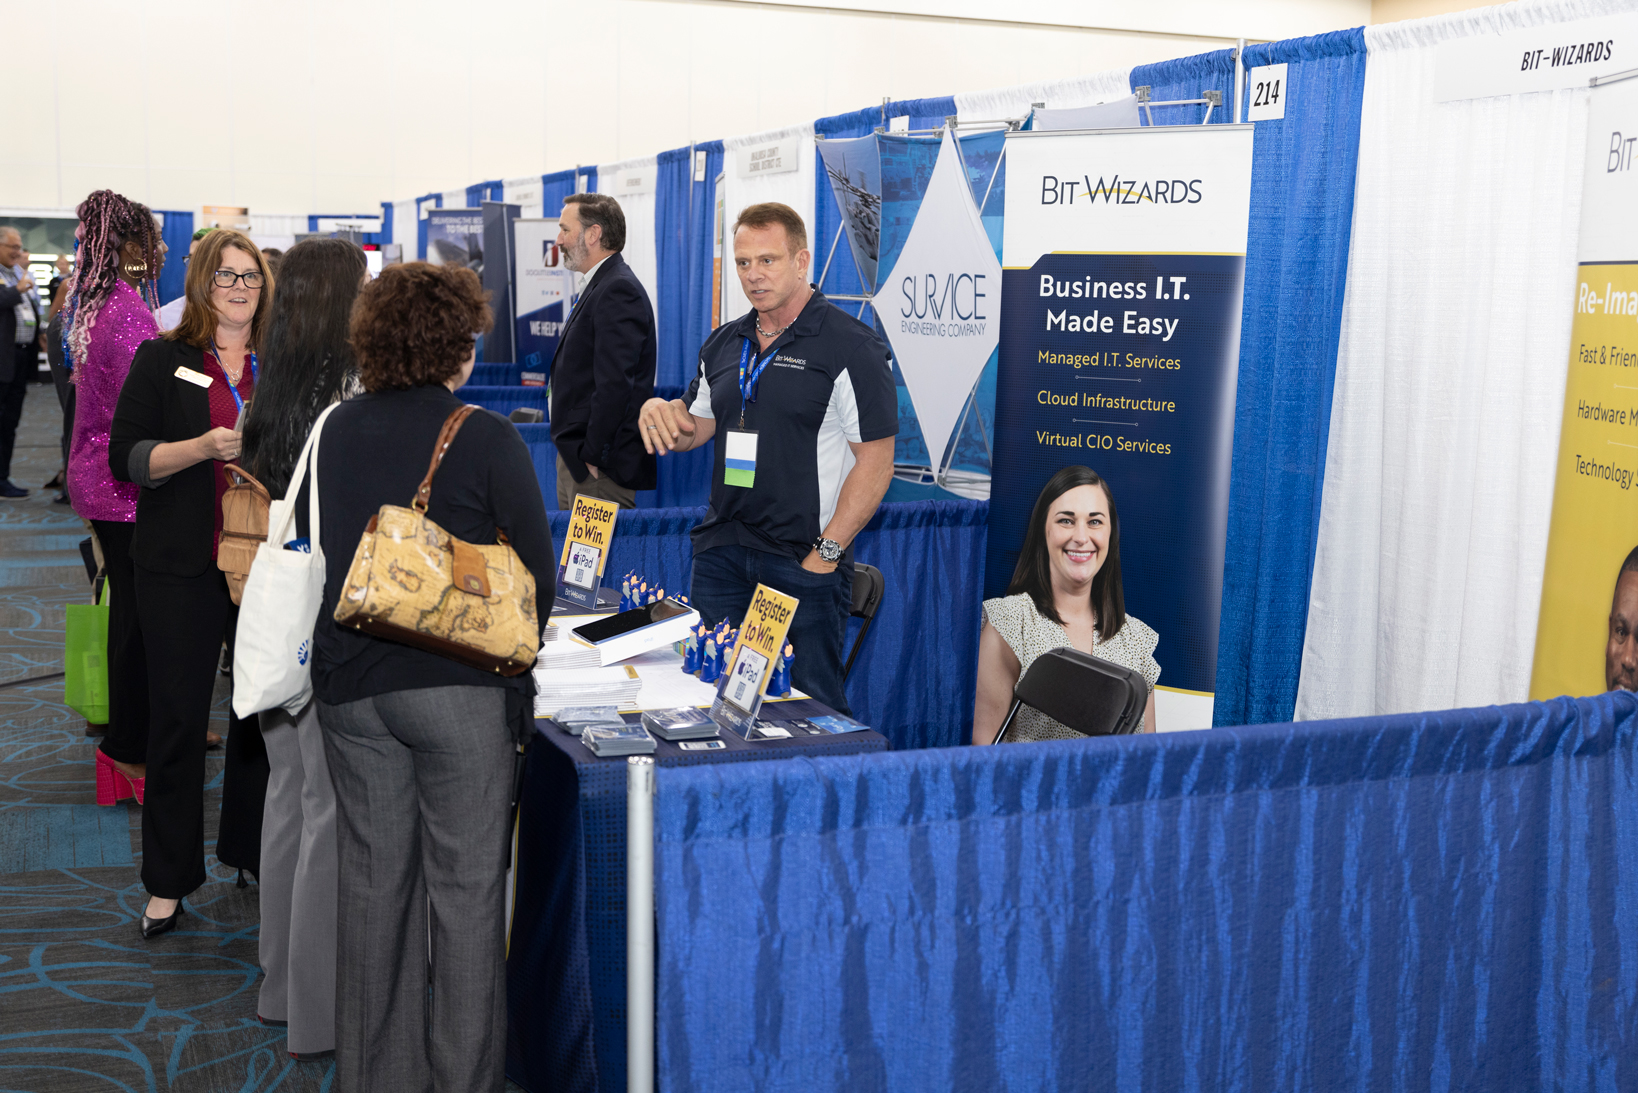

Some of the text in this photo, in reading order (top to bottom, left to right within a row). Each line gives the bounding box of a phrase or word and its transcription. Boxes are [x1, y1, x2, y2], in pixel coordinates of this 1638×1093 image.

[1521, 40, 1613, 71] BIT-WIZARDS
[1254, 80, 1280, 106] 214
[1607, 131, 1637, 173] BIT
[1041, 174, 1202, 205] BIT WIZARDS
[1039, 274, 1190, 300] Business I.T.
[1578, 282, 1638, 316] Re-Ima
[530, 321, 541, 335] WE
[541, 321, 557, 337] HELP
[901, 320, 986, 337] ENGINEERING COMPANY
[1046, 309, 1179, 342] Made Easy
[1038, 350, 1181, 370] Managed I.T. Services
[1579, 344, 1638, 368] Fast & Frien
[1037, 390, 1176, 412] Cloud Infrastructure
[1577, 399, 1626, 425] Hardware
[1036, 430, 1172, 455] Virtual CIO Services
[1576, 454, 1634, 490] Technology
[575, 499, 613, 523] Register
[573, 522, 604, 545] to Win.
[578, 554, 594, 569] iPad
[752, 589, 791, 624] Register
[744, 620, 774, 653] to Win.
[742, 662, 760, 683] iPad
